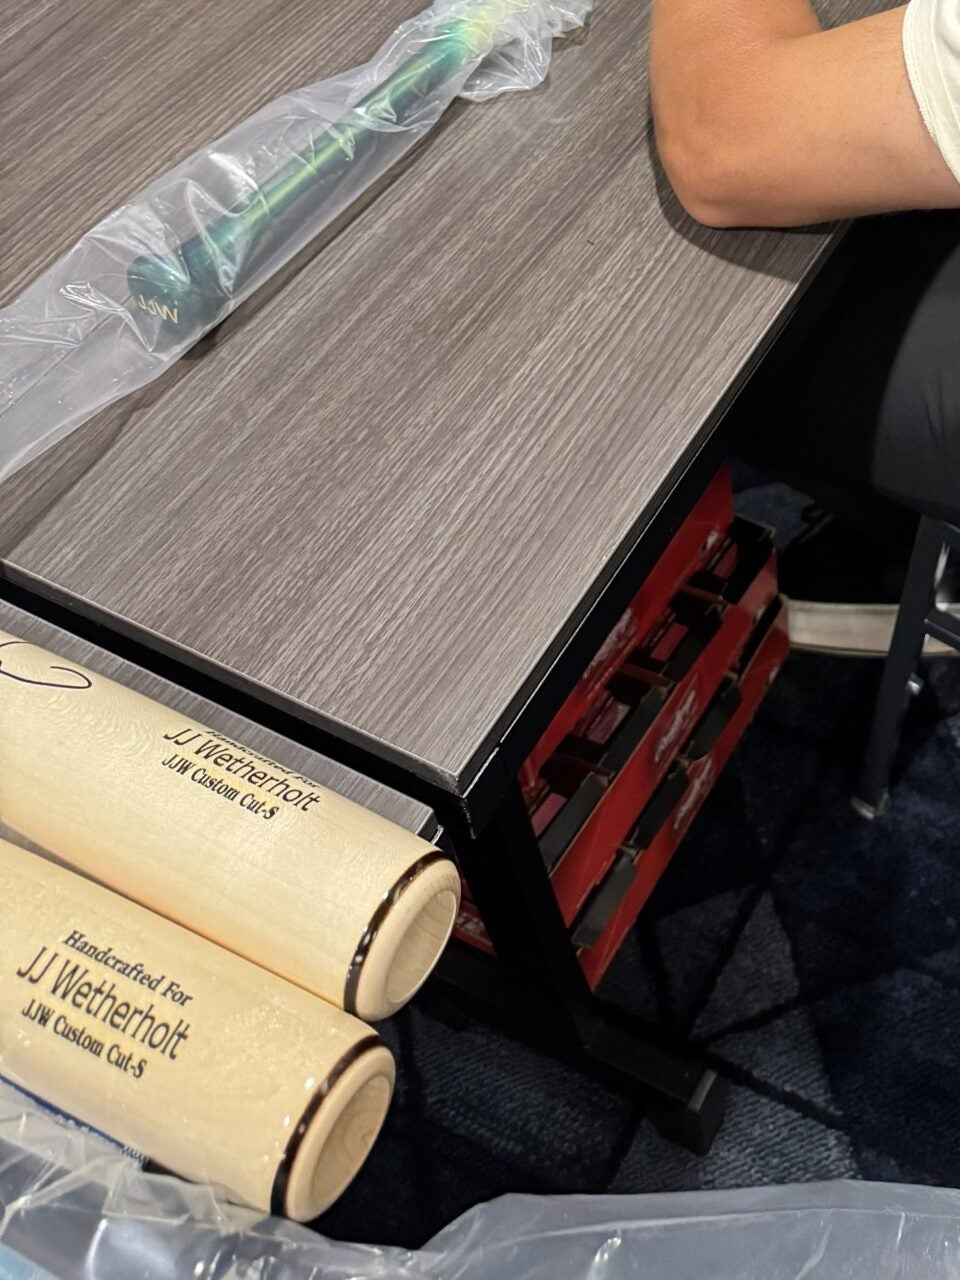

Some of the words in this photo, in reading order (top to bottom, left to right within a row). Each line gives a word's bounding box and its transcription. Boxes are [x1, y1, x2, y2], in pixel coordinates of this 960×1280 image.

[161, 753, 196, 777] JJW
[190, 767, 241, 802] Custom
[239, 792, 281, 820] Cut-S
[163, 728, 202, 747] JJ
[194, 739, 321, 812] Wetherholt
[16, 946, 60, 984] JJ
[50, 959, 191, 1061] Wetherholt
[63, 929, 166, 992] Handcrafted
[161, 980, 194, 1007] For
[21, 998, 55, 1028] JJW
[53, 1014, 106, 1058] Custom
[106, 1043, 148, 1079] Cut-S
